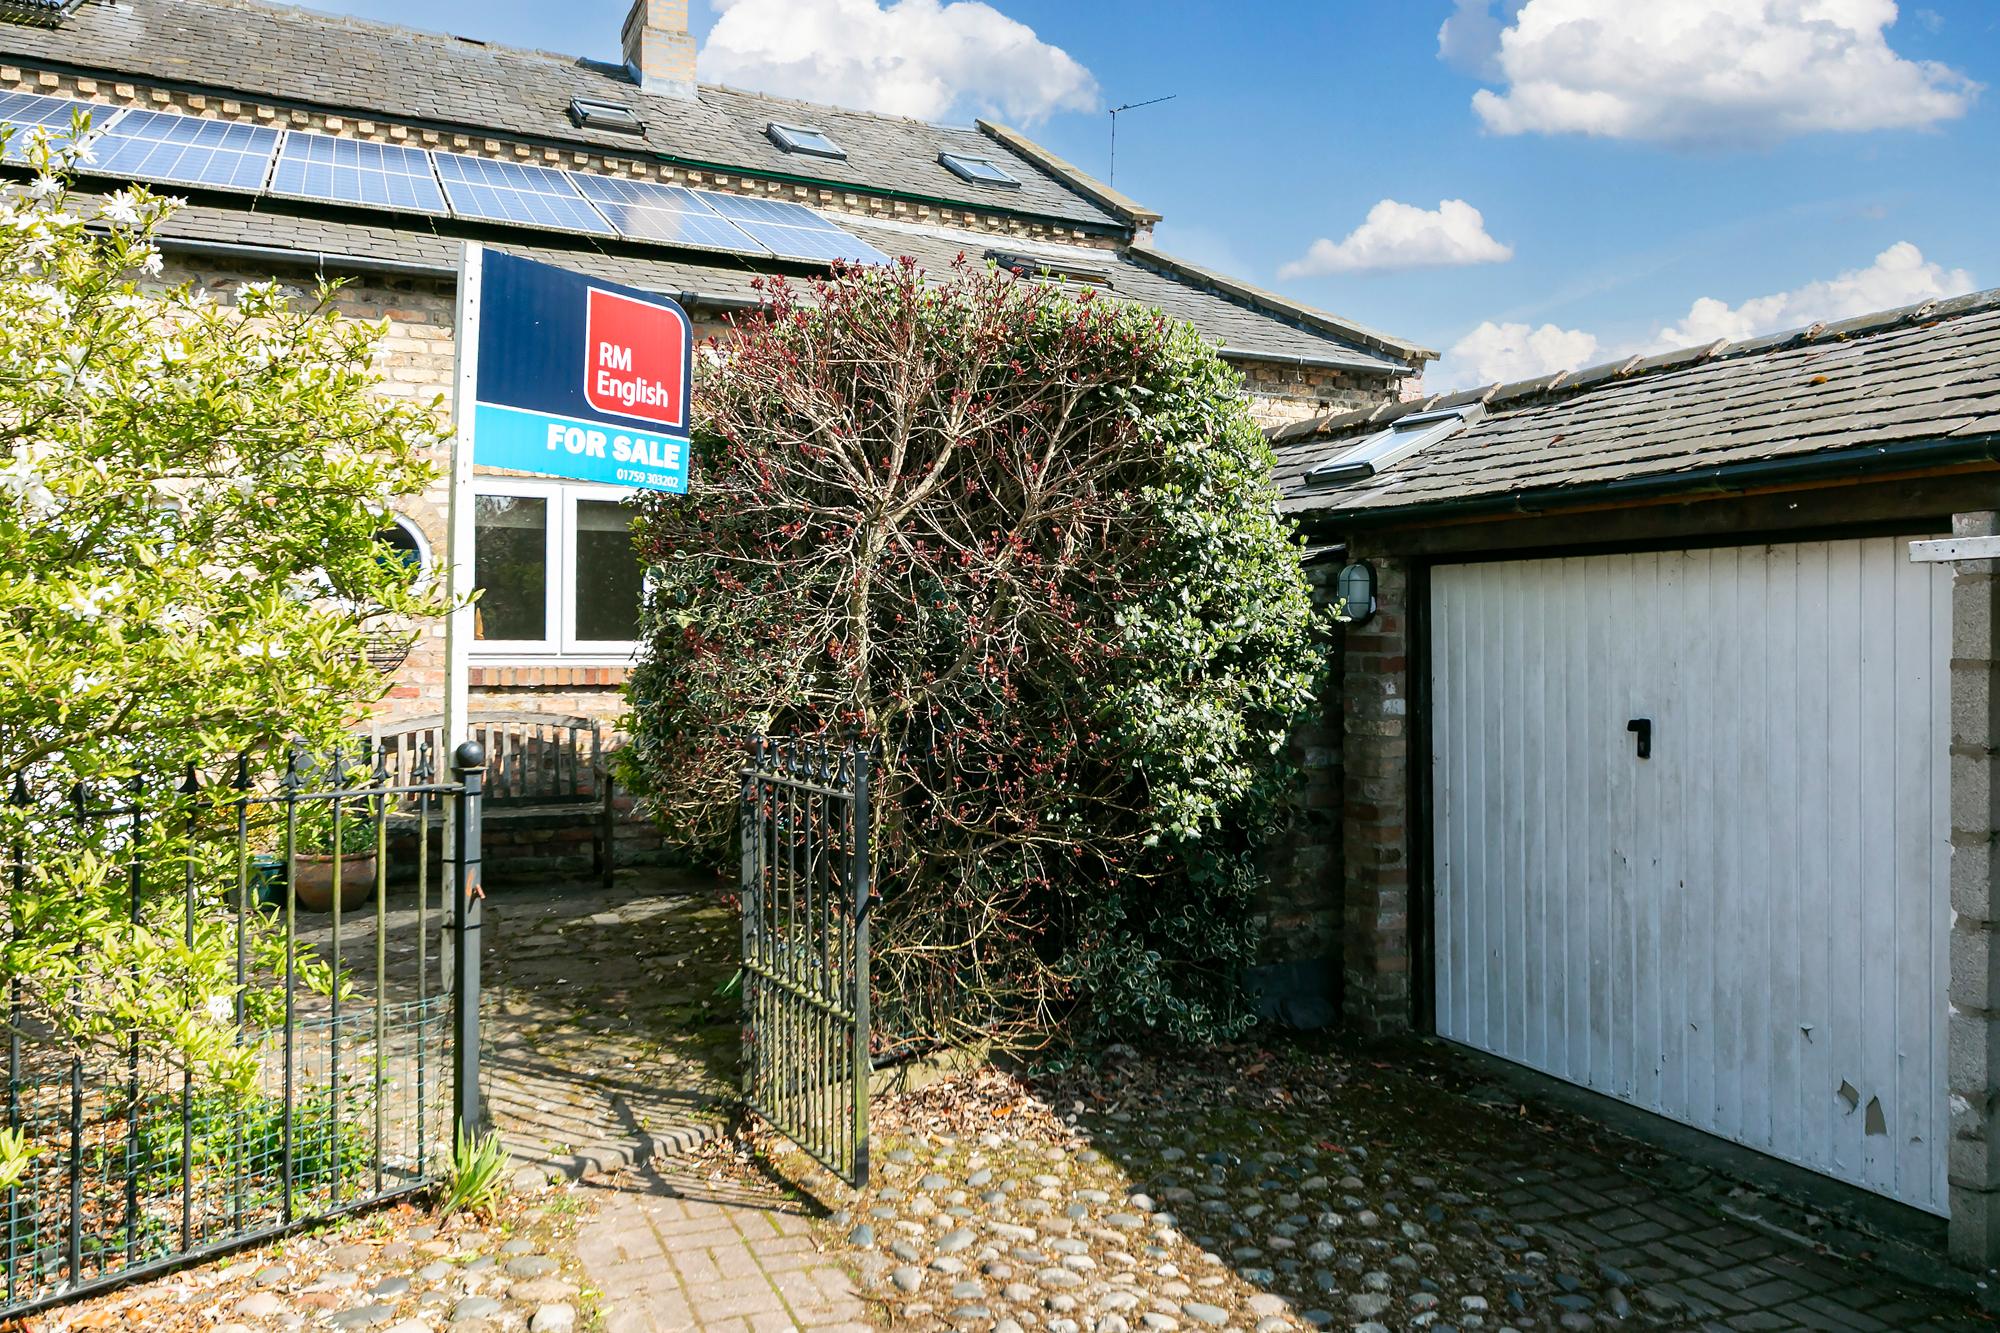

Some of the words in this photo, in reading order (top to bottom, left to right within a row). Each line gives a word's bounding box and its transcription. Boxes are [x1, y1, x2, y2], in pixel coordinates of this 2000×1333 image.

[599, 342, 632, 372] RM
[597, 370, 668, 407] English
[547, 424, 606, 458] FOR
[612, 435, 680, 469] SALE
[616, 468, 646, 482] 01759
[646, 473, 679, 488] 303202
